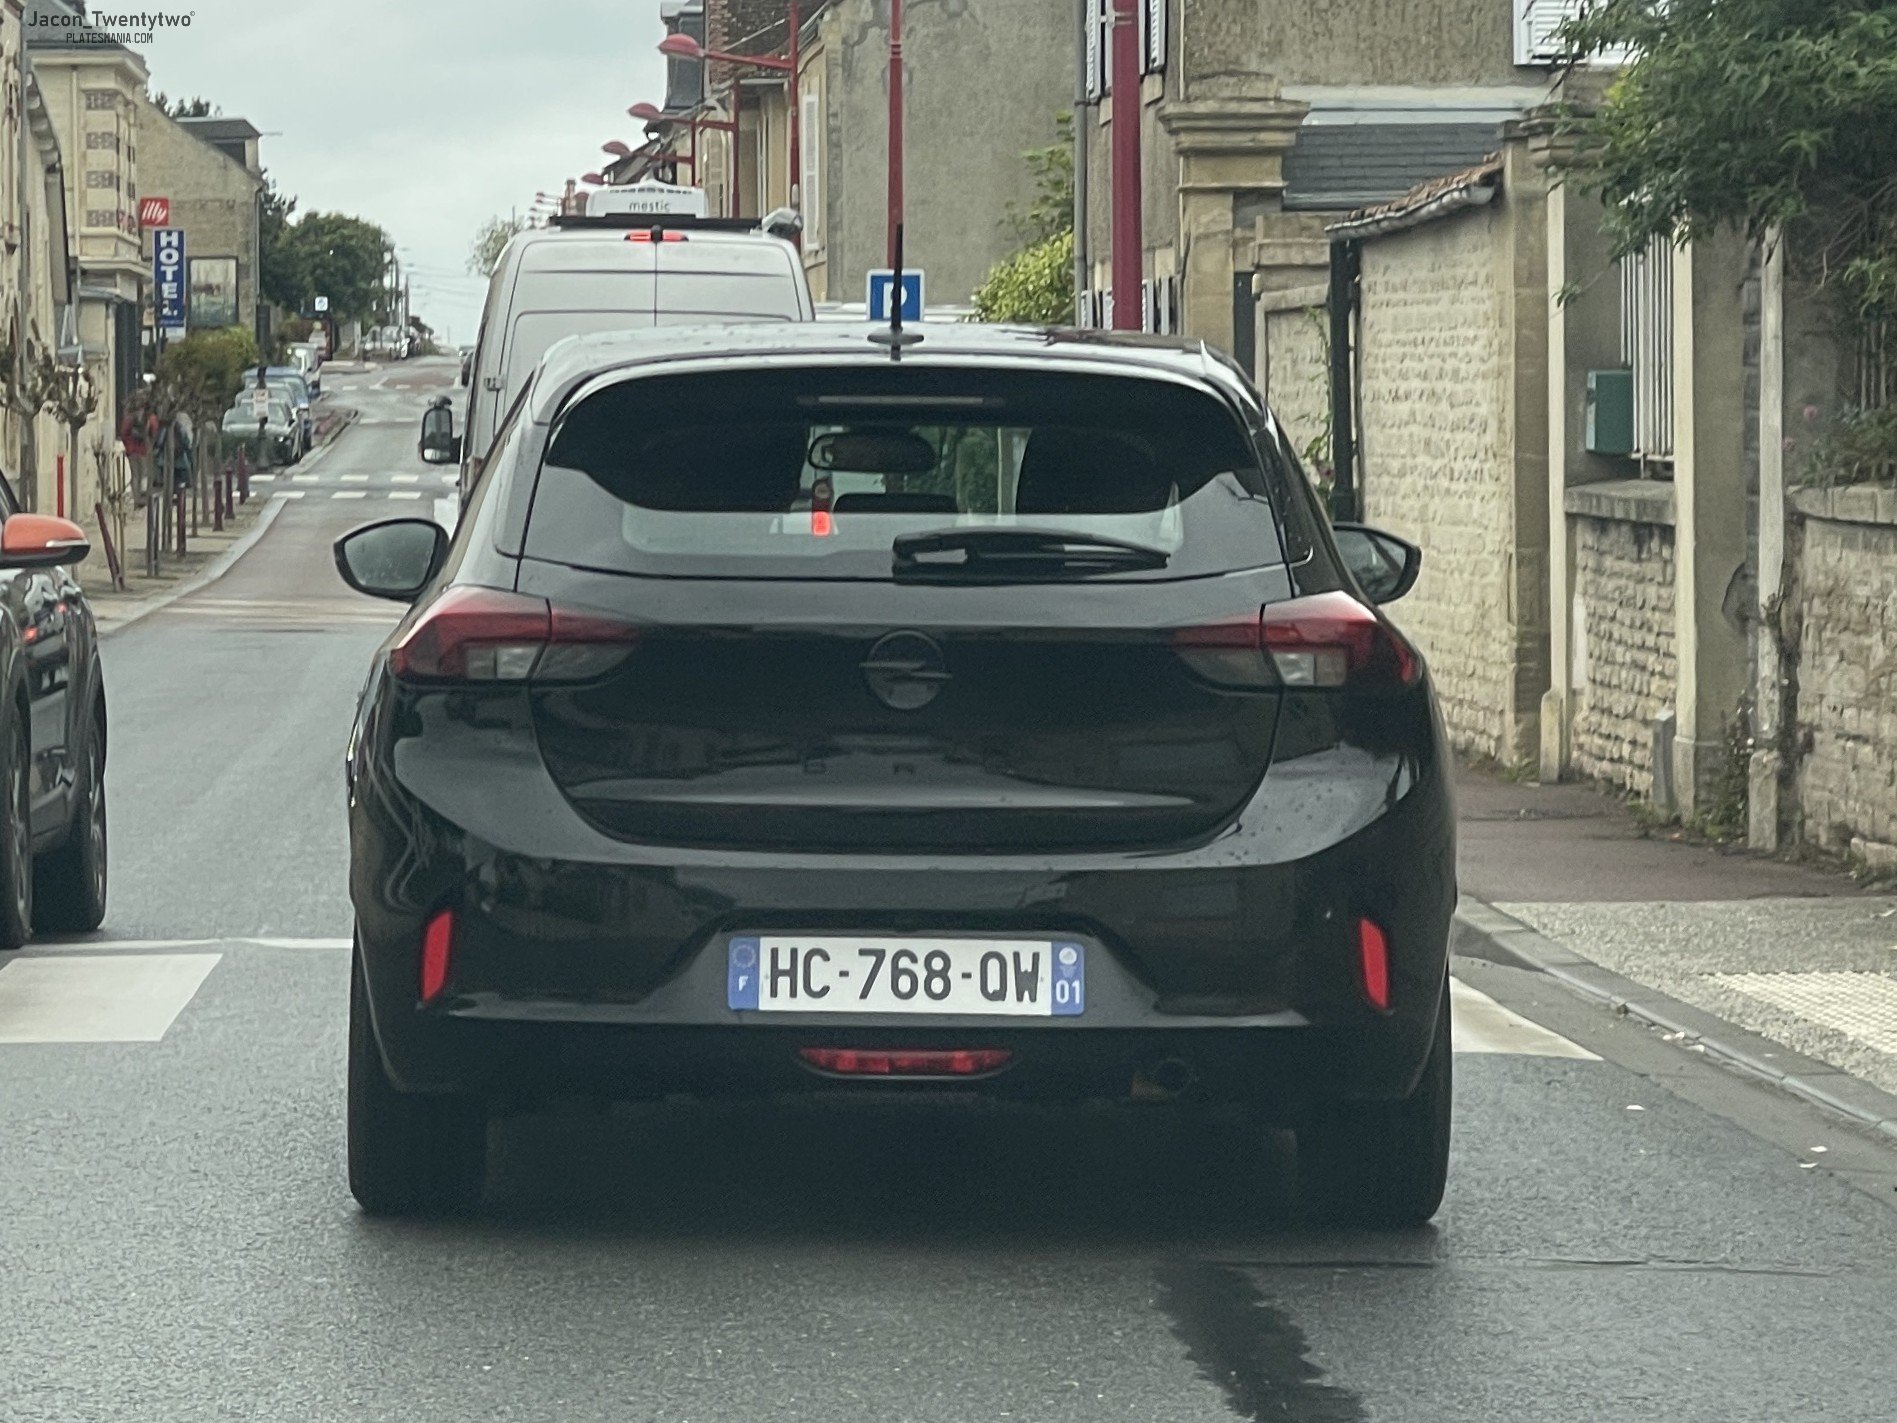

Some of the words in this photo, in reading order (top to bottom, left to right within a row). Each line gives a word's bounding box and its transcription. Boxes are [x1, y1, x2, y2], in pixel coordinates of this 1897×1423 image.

[142, 201, 167, 224] illy
[628, 200, 671, 213] mestic
[770, 947, 1040, 1003] HC-768-QW
[1055, 980, 1080, 1004] 01
